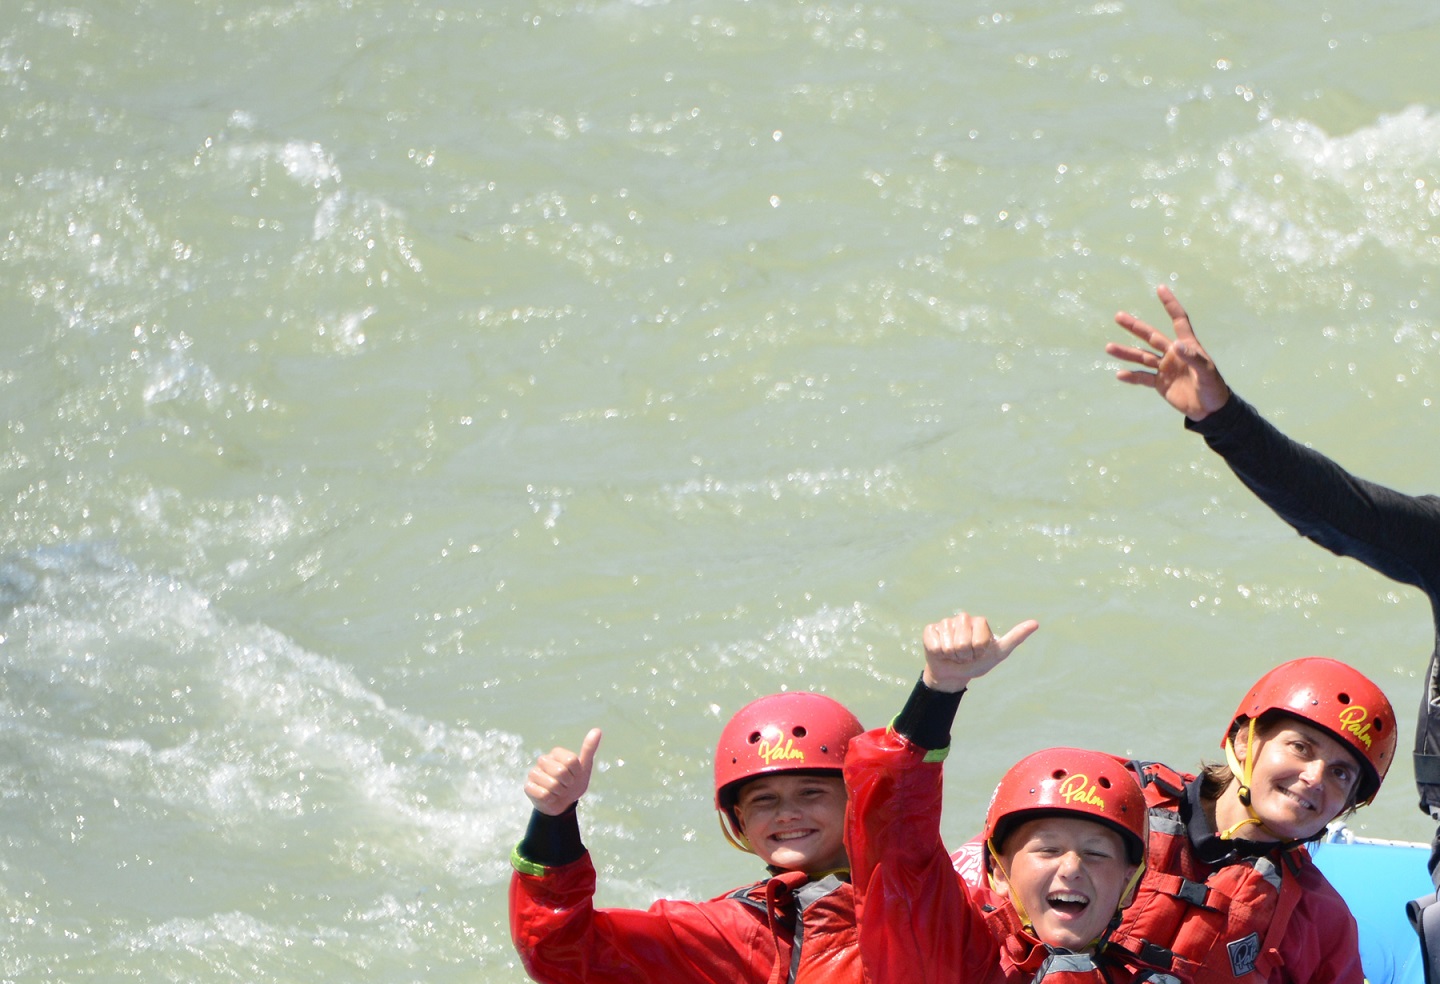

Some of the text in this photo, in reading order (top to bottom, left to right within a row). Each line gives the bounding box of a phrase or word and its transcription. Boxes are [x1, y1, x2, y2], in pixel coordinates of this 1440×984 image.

[1339, 705, 1371, 749] Palm
[758, 728, 804, 764] Palm
[1059, 773, 1104, 810] Palm
